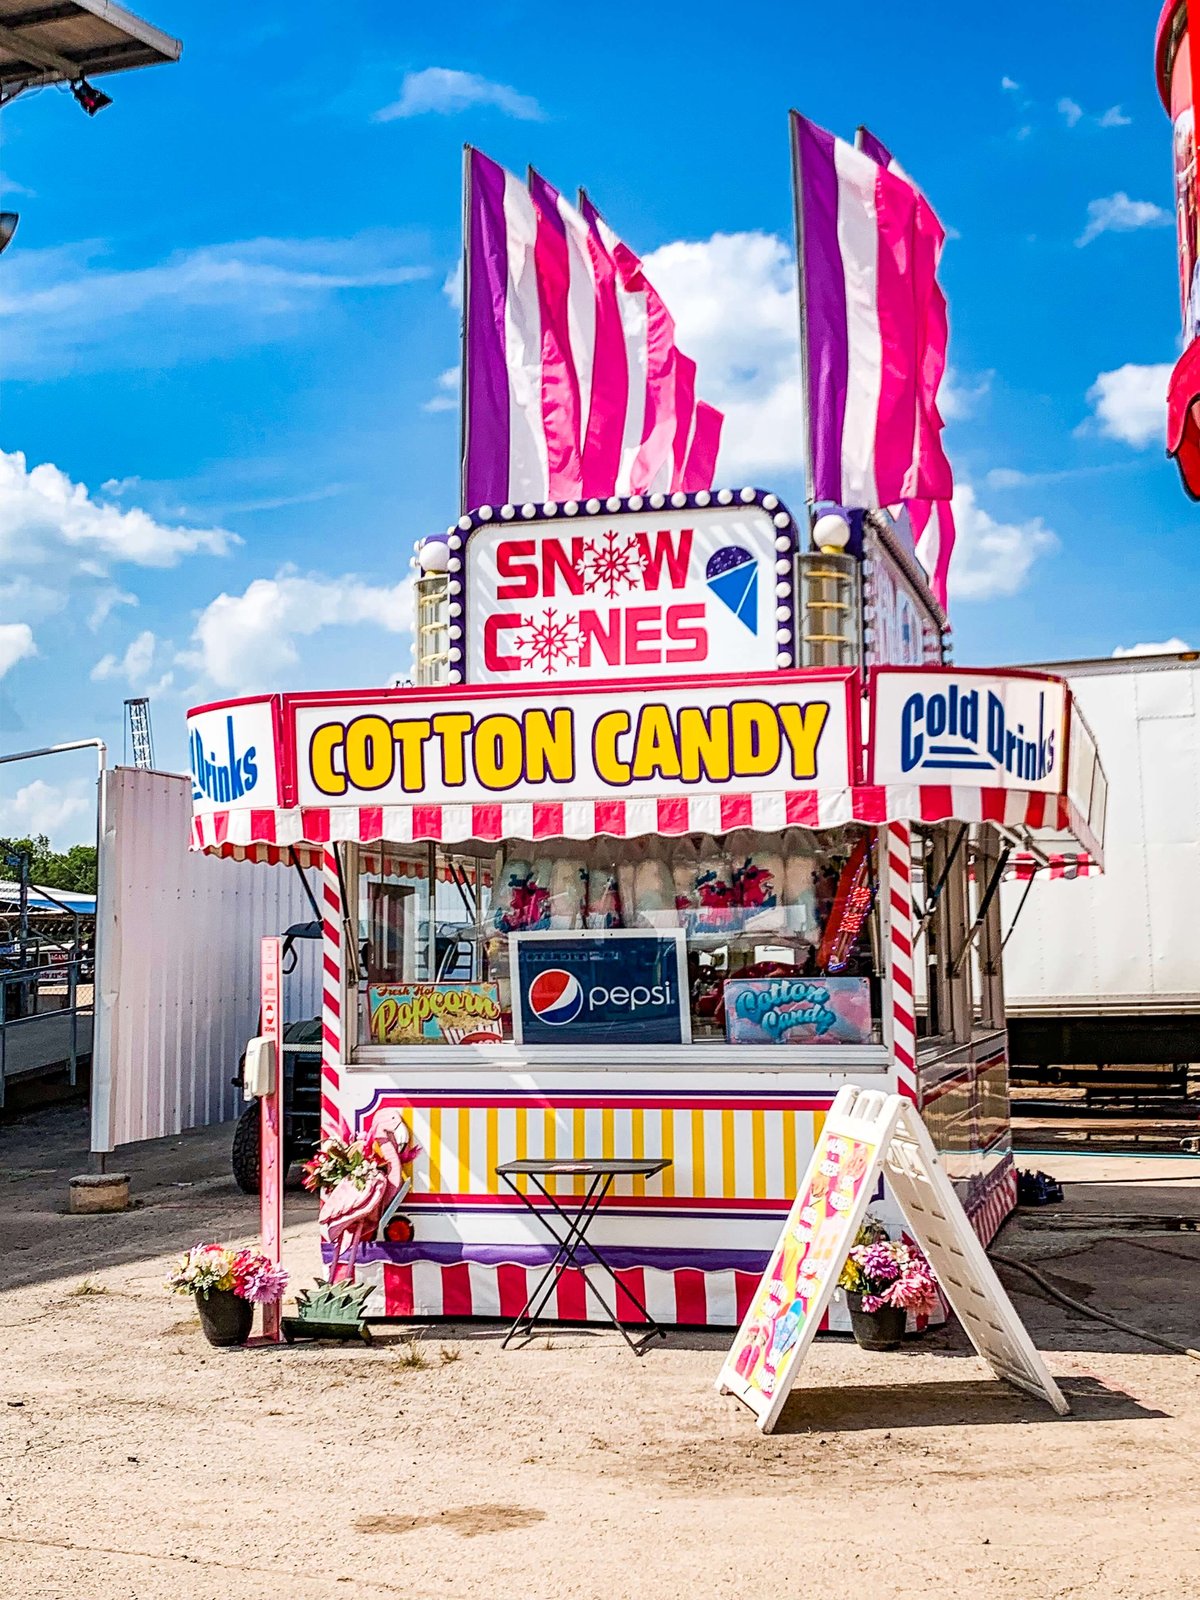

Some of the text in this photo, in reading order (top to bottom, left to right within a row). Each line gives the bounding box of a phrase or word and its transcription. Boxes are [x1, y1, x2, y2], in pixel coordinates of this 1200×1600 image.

[309, 699, 830, 796] COTTON CANDY
[901, 684, 1055, 782] Cold Drinks
[195, 716, 258, 803] Drinks
[377, 985, 435, 997] Fresh Hot
[589, 981, 671, 1011] pepsi
[735, 979, 831, 1024] Cotton
[371, 990, 502, 1044] Popcorn
[761, 1004, 837, 1040] Candy
